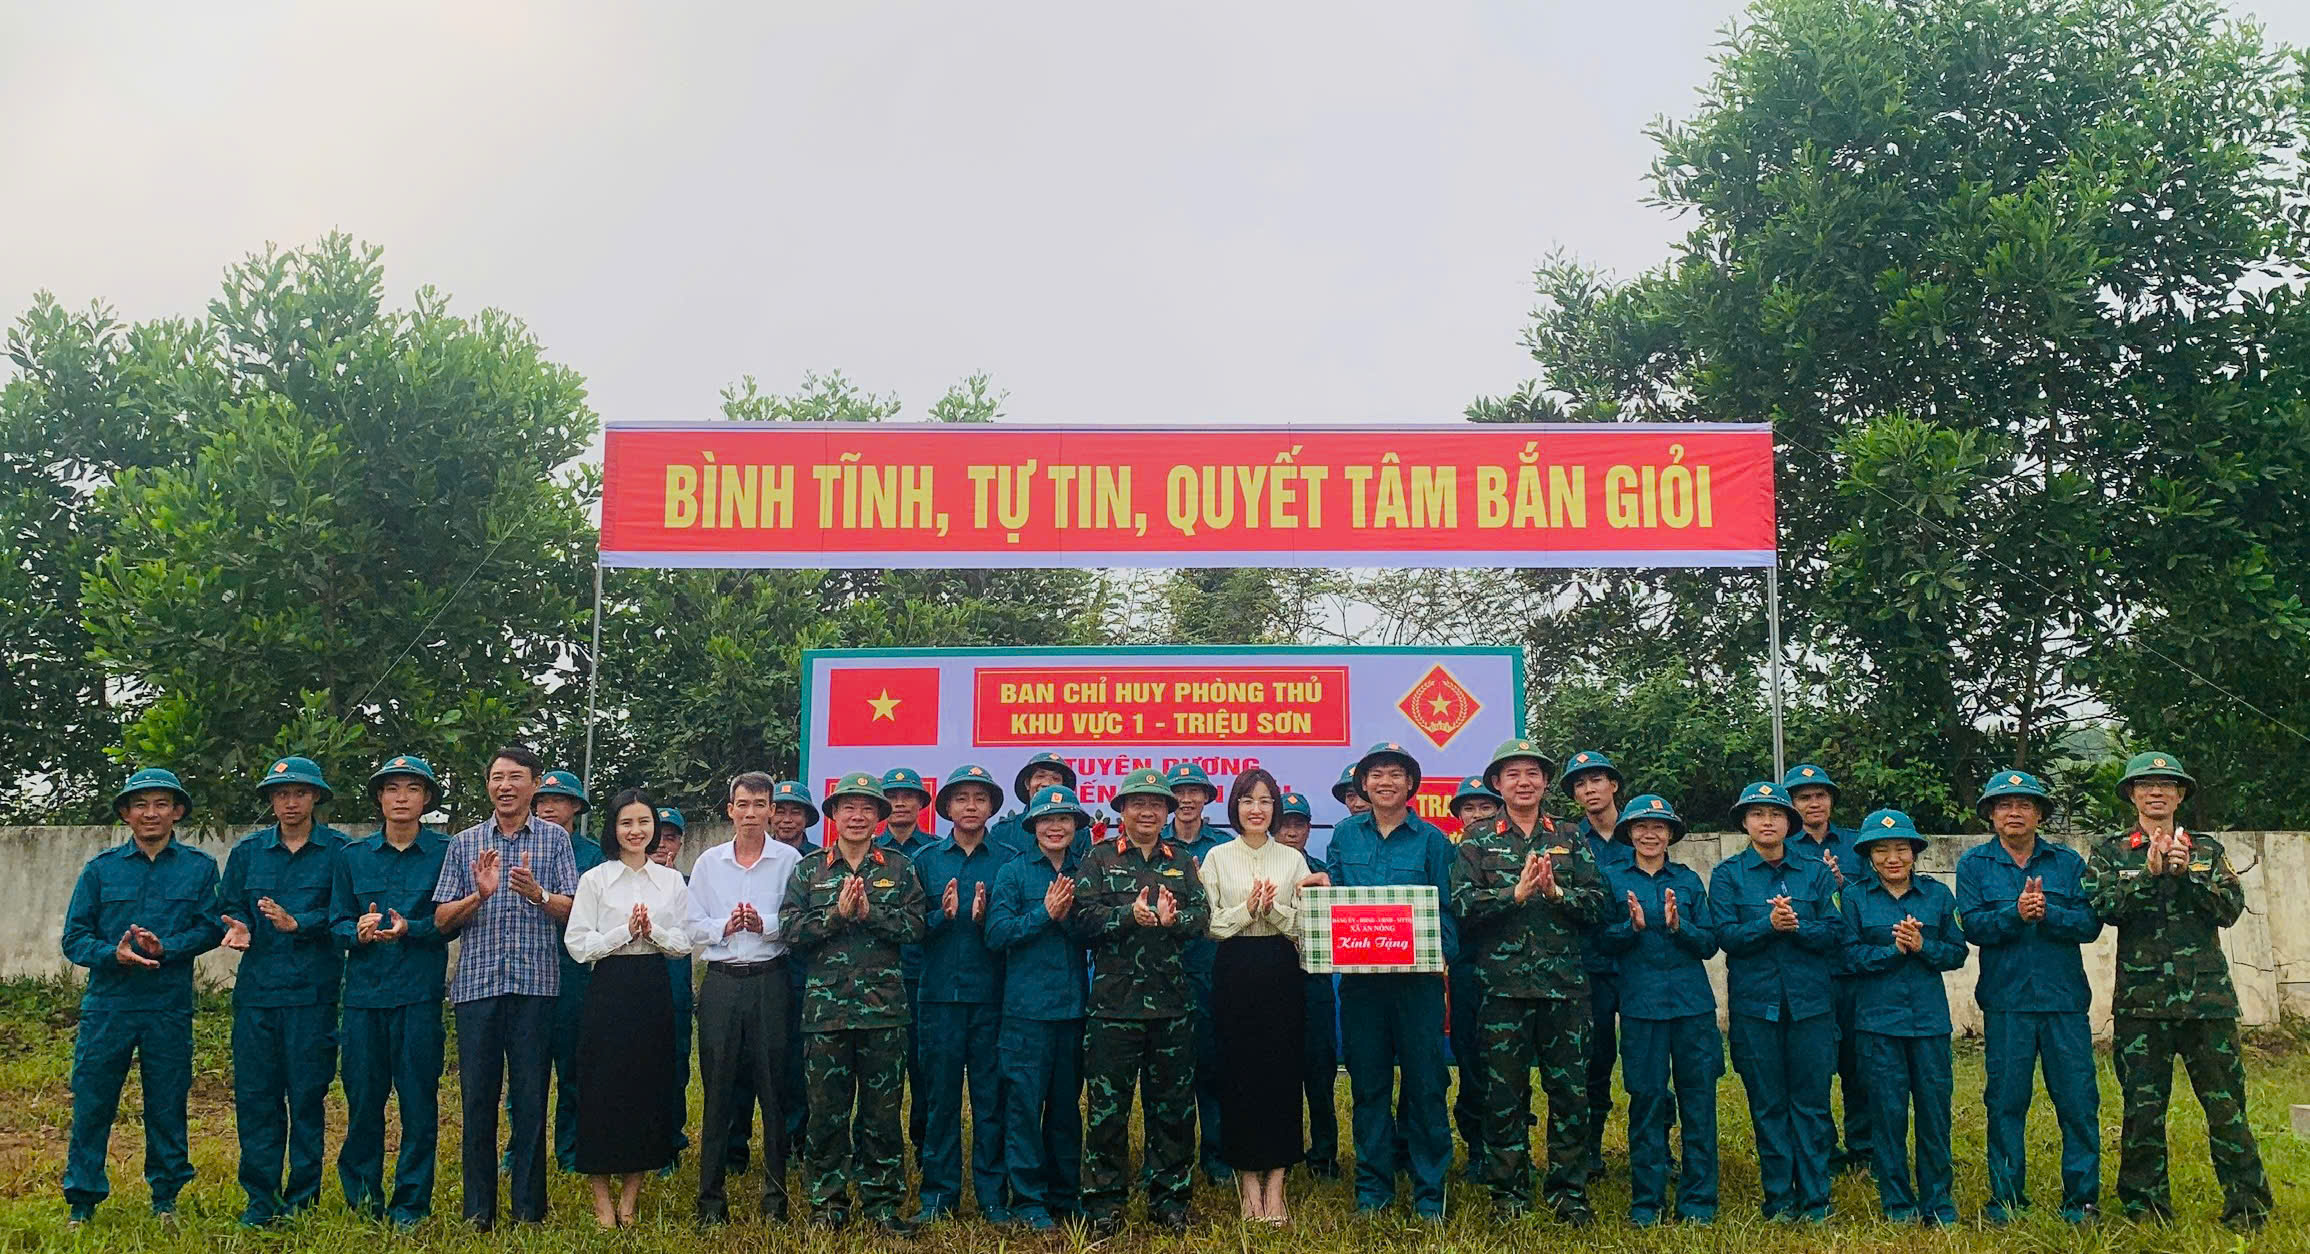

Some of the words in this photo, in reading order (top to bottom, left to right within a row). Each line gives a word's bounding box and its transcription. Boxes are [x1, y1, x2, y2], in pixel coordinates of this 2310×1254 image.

[664, 451, 794, 529] BÌNH
[813, 452, 949, 537] TĨNH,
[968, 459, 1037, 543] TỰ
[1048, 465, 1147, 537] TIN,
[1165, 445, 1329, 536] QUYẾT
[1345, 453, 1457, 529] TÂM
[1477, 442, 1586, 529] BẮN
[1606, 444, 1713, 529] GIỎI
[1000, 683, 1054, 704] BAN
[1063, 676, 1106, 703] CHỈ
[1116, 683, 1166, 703] HUY
[1174, 677, 1264, 703] PHÒNG
[1273, 676, 1322, 702] THỦ
[1011, 714, 1063, 734] KHU
[1072, 711, 1123, 738] VỰC
[1133, 714, 1144, 734] 1
[1173, 711, 1248, 738] TRIỆU
[1257, 711, 1312, 734] SƠN
[1337, 936, 1371, 949] Kính
[1375, 936, 1409, 951] Tặng
